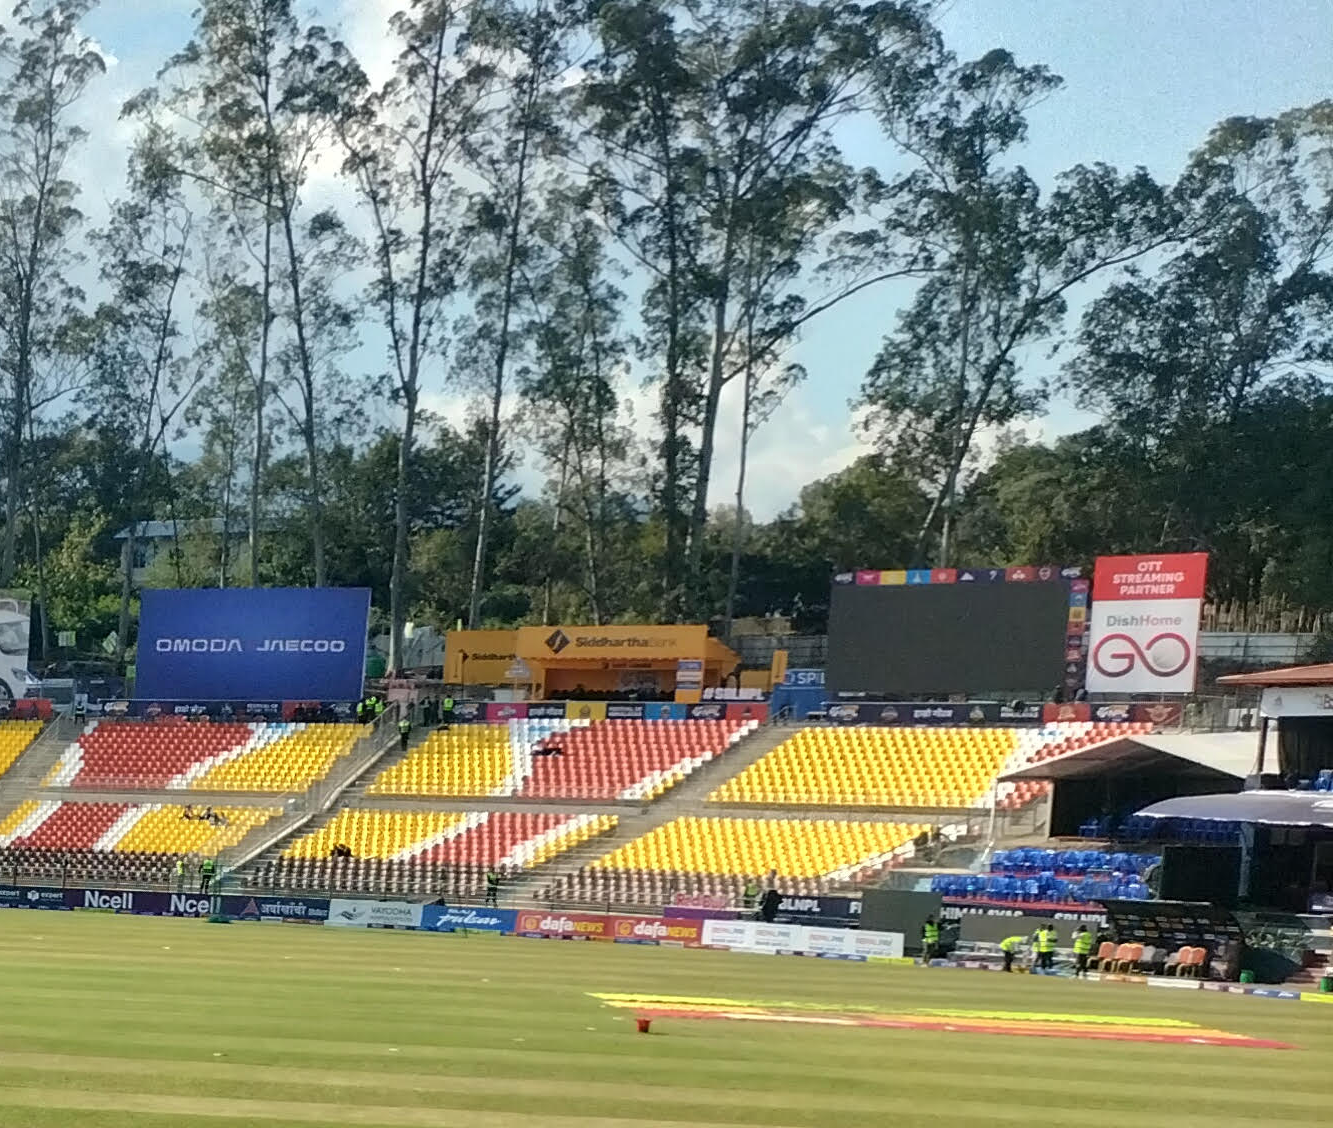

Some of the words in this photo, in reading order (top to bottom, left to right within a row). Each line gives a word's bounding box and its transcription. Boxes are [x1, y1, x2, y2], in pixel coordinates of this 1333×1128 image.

[1137, 561, 1163, 572] OTT
[1112, 571, 1185, 584] STREAMING
[1119, 584, 1175, 595] PARTNER
[1106, 614, 1182, 627] DishHome
[155, 638, 243, 652] OMODA
[256, 639, 346, 653] JAECOO
[1093, 632, 1191, 678] GO
[84, 890, 133, 909] Ncell
[170, 893, 222, 913] Ncell
[539, 916, 605, 934] dafaNEWS
[633, 920, 698, 938] dafaNEWS
